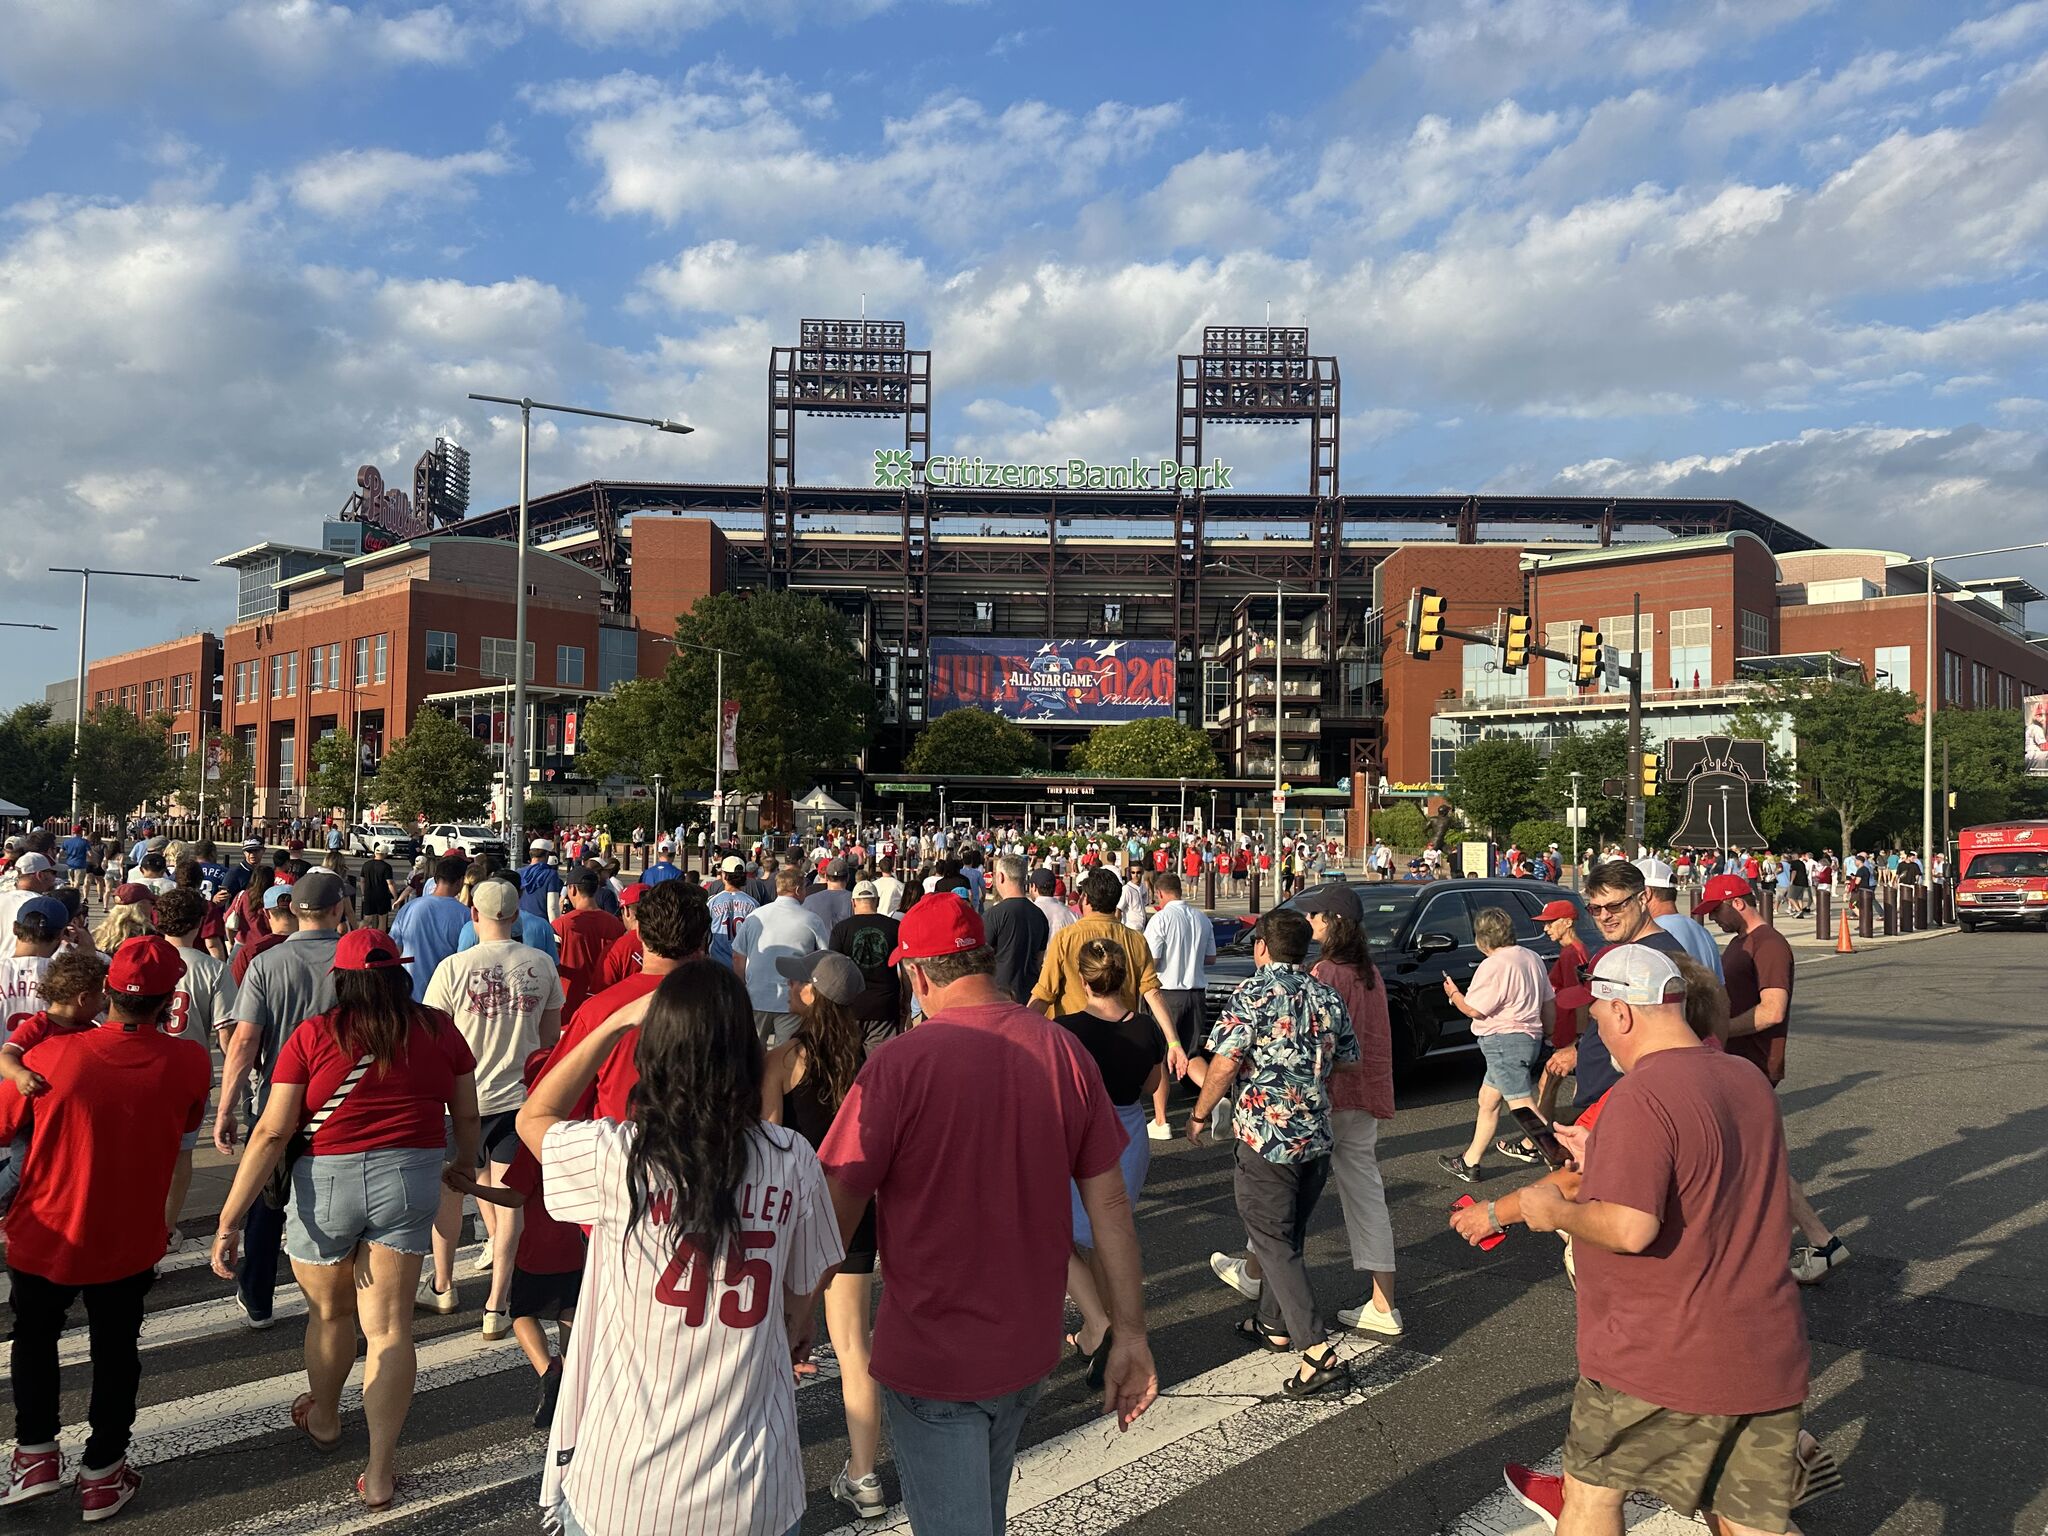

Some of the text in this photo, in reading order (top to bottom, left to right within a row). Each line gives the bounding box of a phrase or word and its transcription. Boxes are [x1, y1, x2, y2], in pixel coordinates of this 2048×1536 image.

[924, 456, 1233, 489] Citizens Bank Park
[929, 655, 1034, 702] JULY
[1009, 671, 1093, 688] ALL STAR GAME
[1074, 656, 1174, 704] 2026
[1096, 692, 1171, 710] Philadelphia
[647, 1184, 793, 1226] WLER
[655, 1231, 776, 1328] 45
